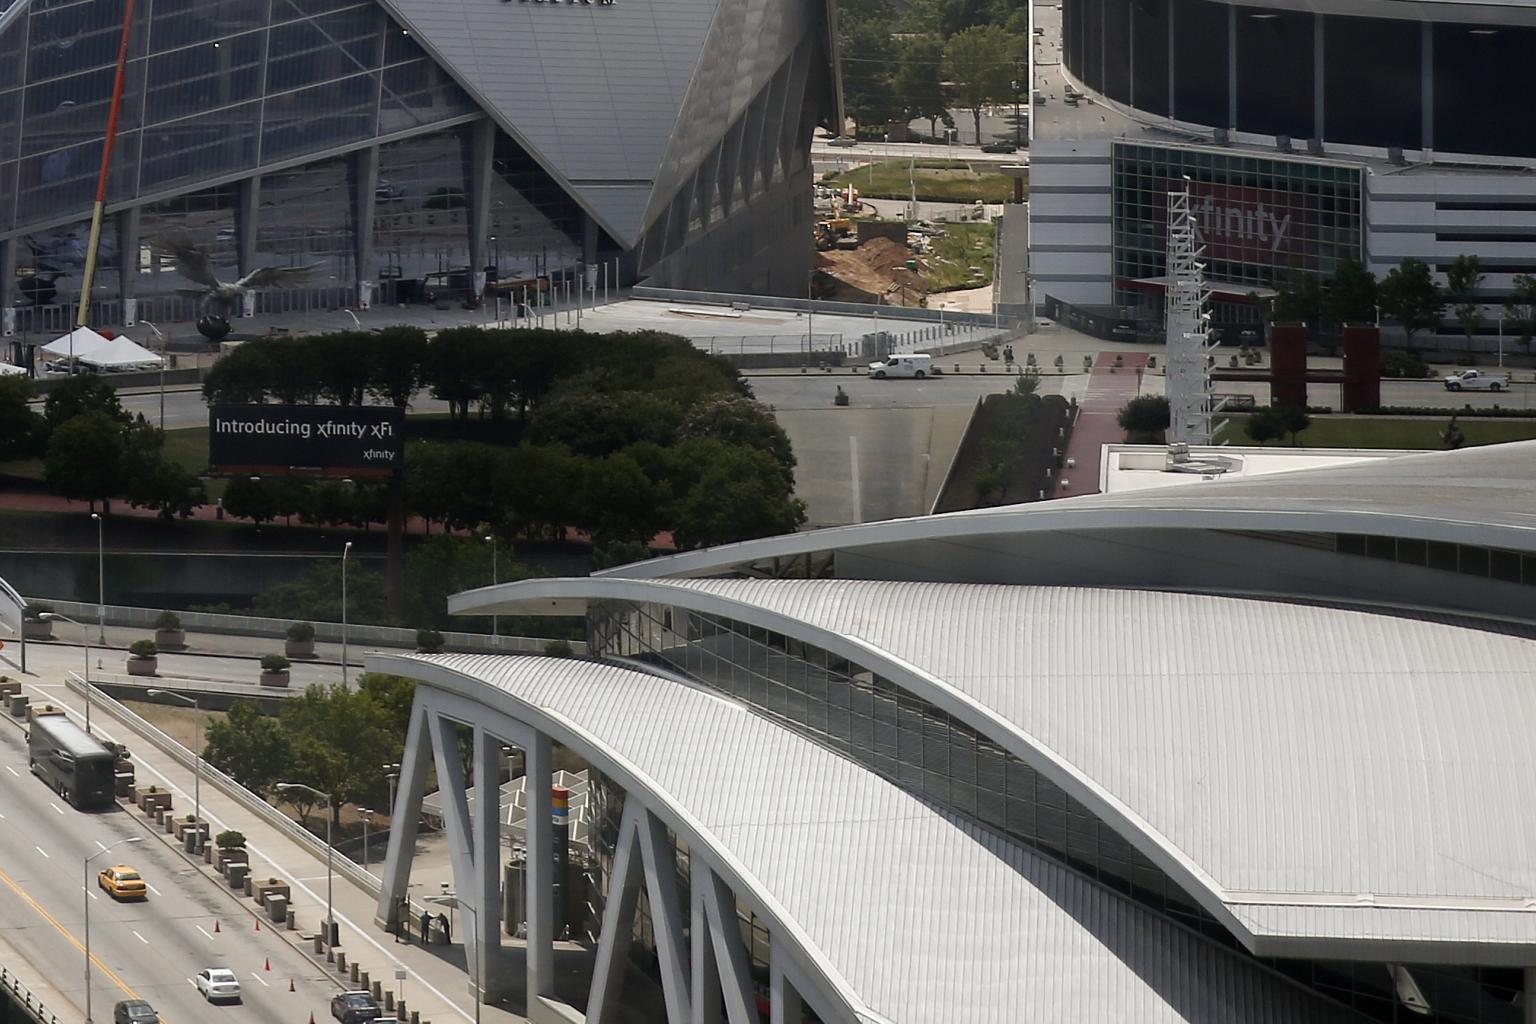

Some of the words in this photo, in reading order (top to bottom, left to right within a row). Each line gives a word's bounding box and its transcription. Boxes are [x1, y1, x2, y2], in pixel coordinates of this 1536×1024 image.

[216, 418, 311, 439] Introducing
[316, 420, 367, 439] xfinity
[371, 421, 393, 440] xFi
[363, 448, 396, 461] xfinity
